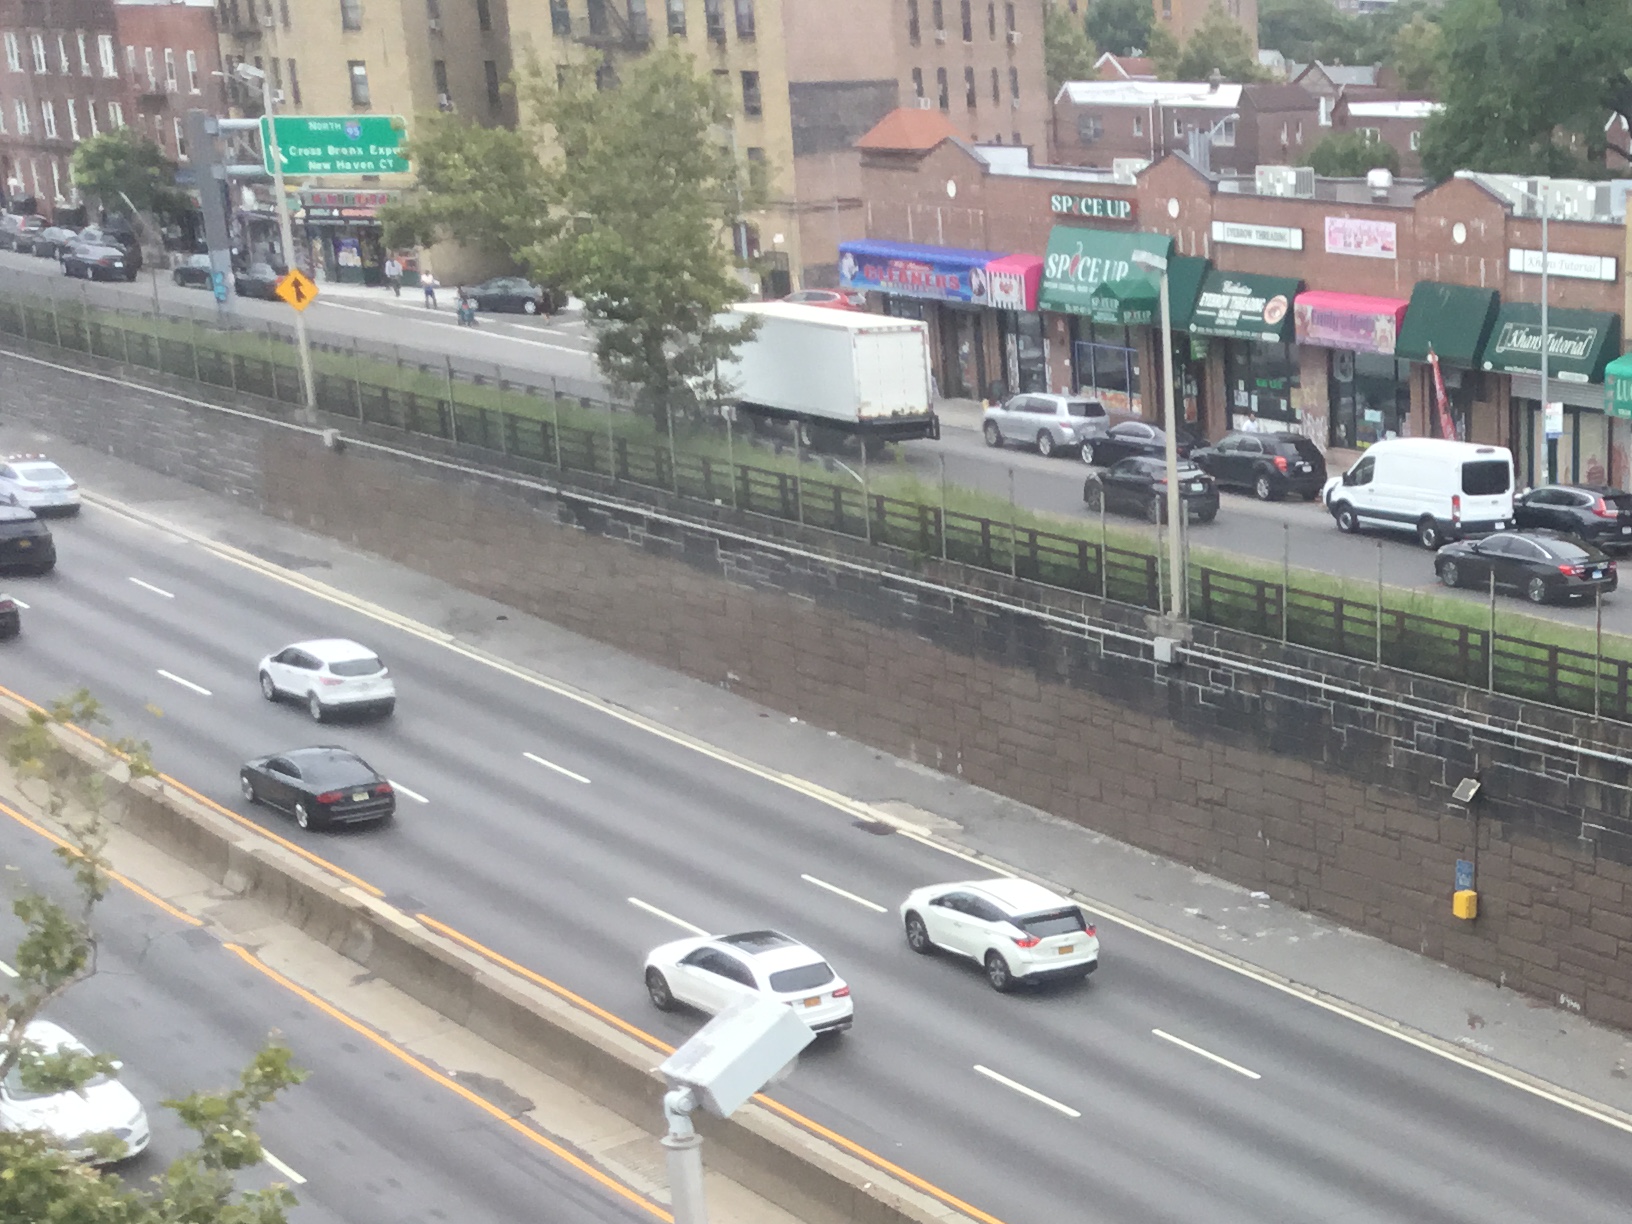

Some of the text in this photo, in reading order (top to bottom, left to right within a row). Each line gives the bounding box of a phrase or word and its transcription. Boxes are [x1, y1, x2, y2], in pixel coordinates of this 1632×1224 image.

[308, 121, 361, 137] NORTH 95
[288, 146, 322, 156] Cross
[327, 145, 364, 156] Bronx
[308, 159, 394, 171] New Haven CT
[1106, 200, 1131, 218] UP
[1102, 260, 1129, 282] UP
[1527, 256, 1597, 273] Khns Tutorial
[863, 264, 961, 290] CLEANERS
[1547, 332, 1593, 356] Tutorial
